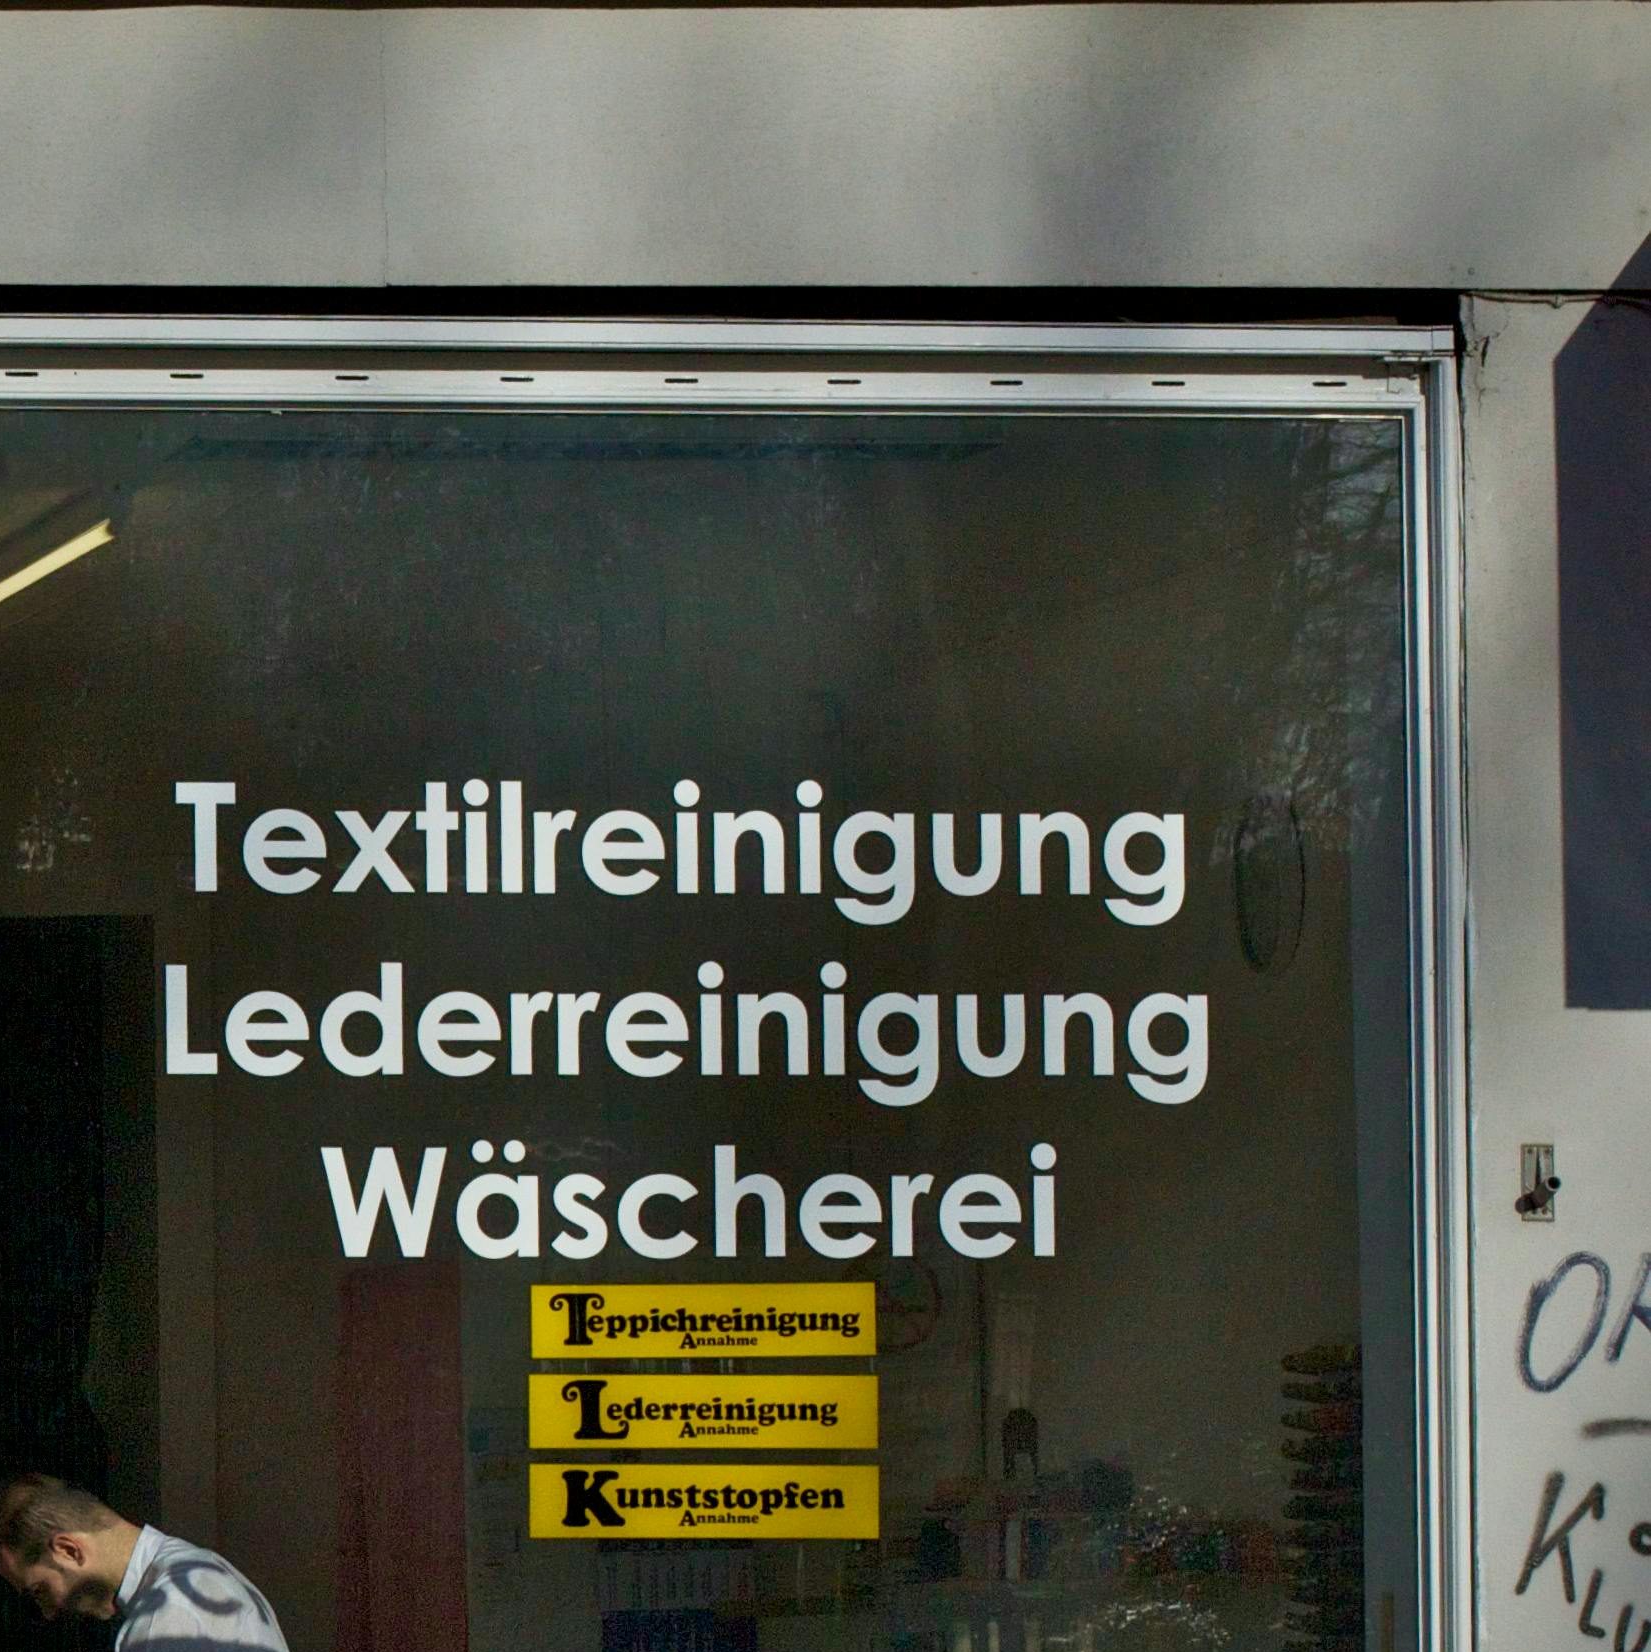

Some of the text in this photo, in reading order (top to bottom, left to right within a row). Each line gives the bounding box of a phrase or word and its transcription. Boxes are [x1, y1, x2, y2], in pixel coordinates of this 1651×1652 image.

[176, 778, 1186, 926] Textilreinigung
[164, 961, 1209, 1106] Lederreinigung
[319, 1139, 1058, 1260] Wäscherei
[549, 1292, 861, 1346] Teppichreinigung
[679, 1333, 758, 1349] Annahme
[561, 1380, 839, 1440] Lederreinigung
[679, 1422, 759, 1438] Annahme
[561, 1470, 846, 1527] Kunststopfen
[679, 1511, 759, 1527] Annahme
